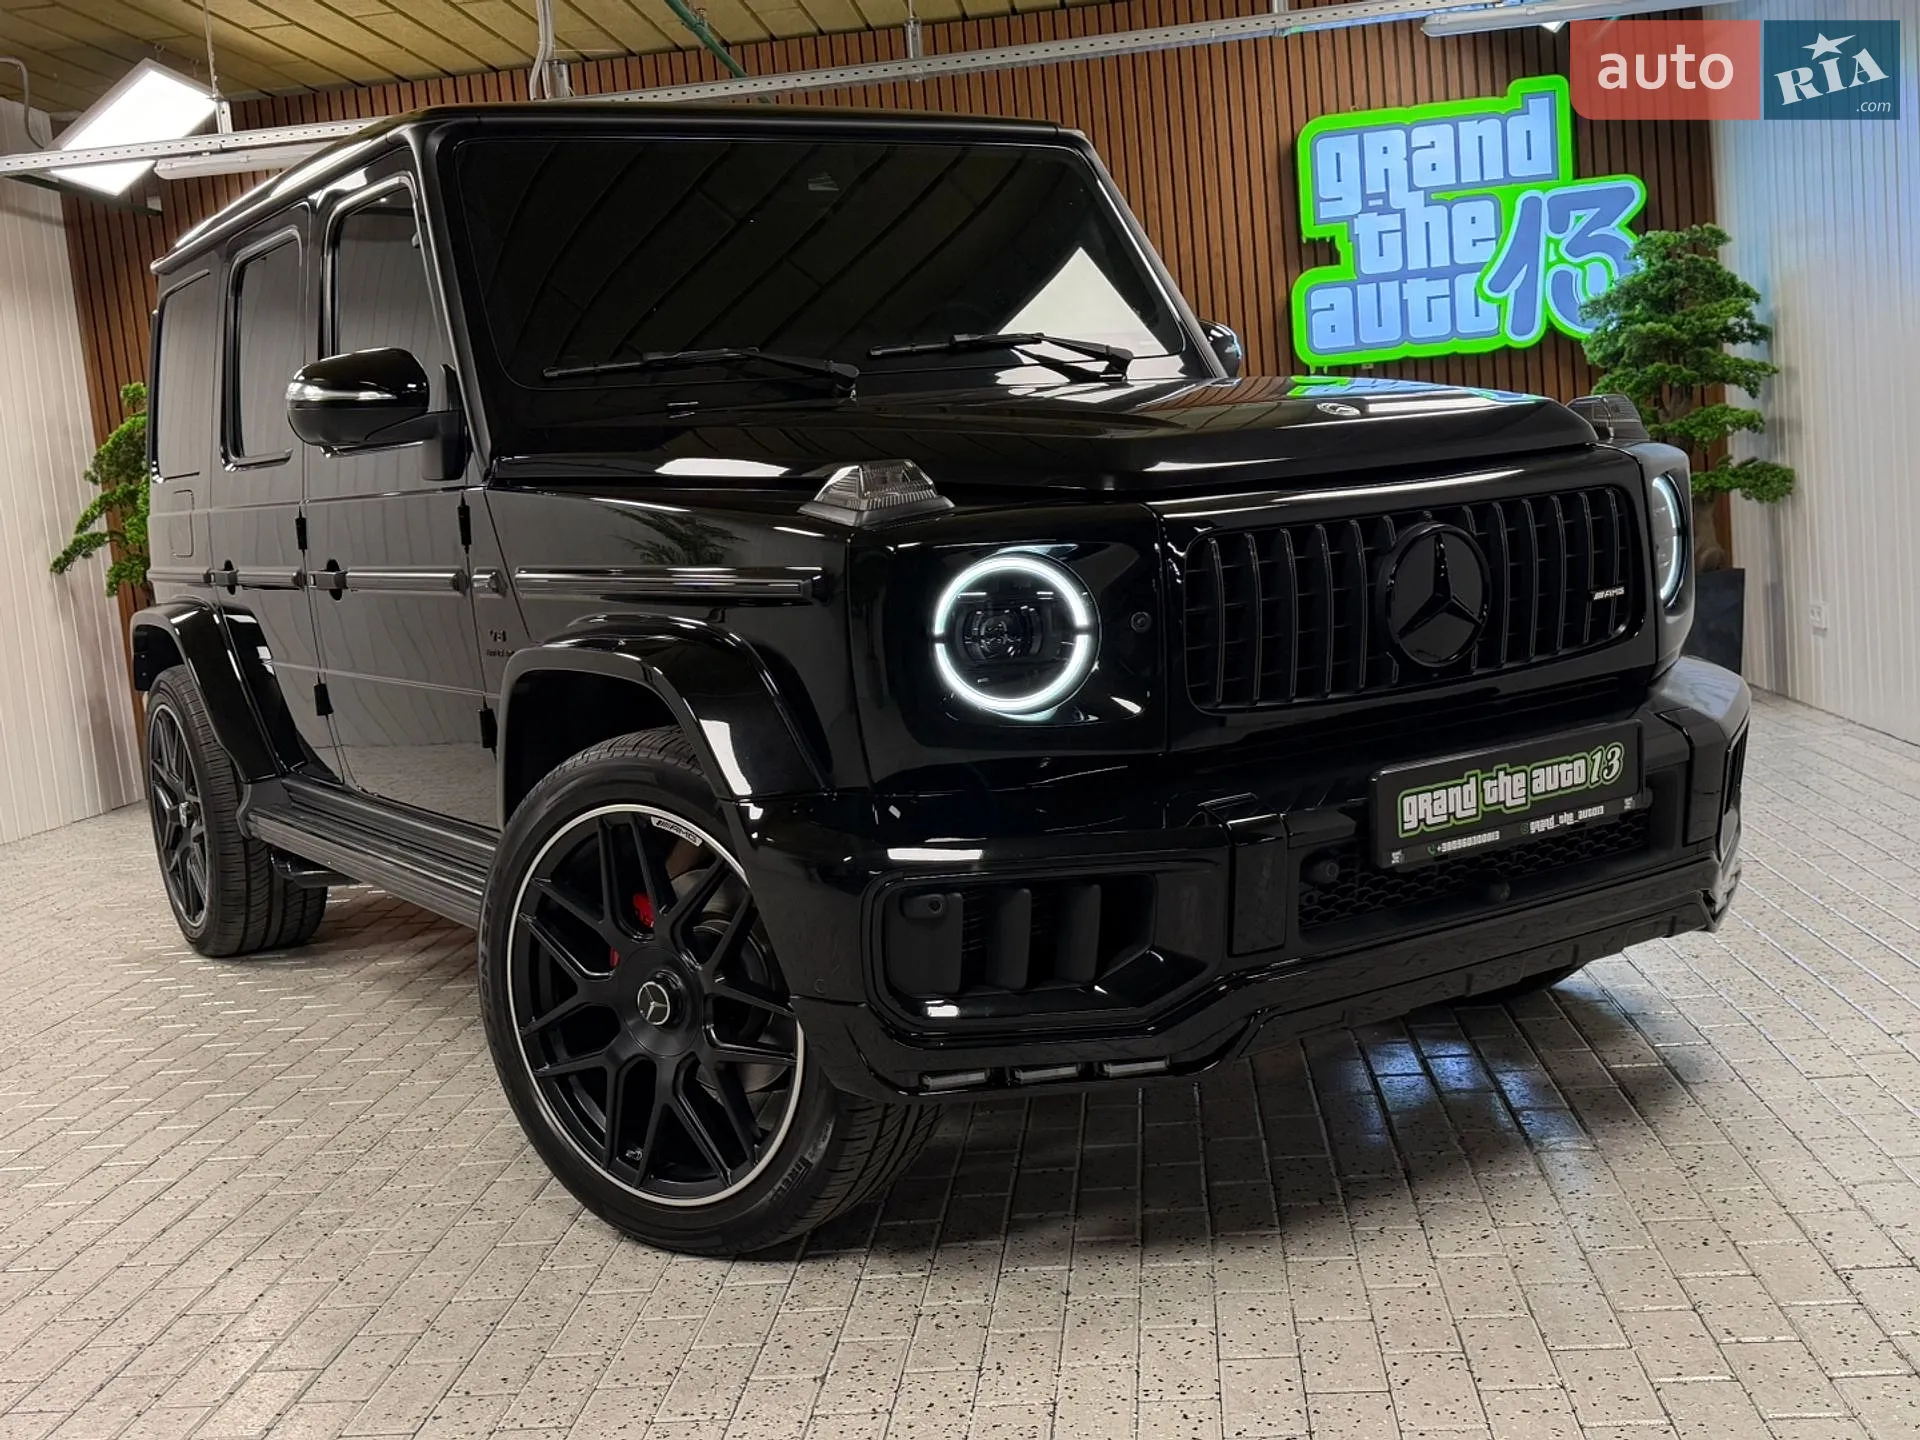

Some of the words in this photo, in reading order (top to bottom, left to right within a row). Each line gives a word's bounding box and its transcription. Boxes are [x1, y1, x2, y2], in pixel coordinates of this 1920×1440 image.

[1317, 95, 1554, 221] grand
[1354, 192, 1498, 275] the
[1309, 272, 1499, 351] auto
[1402, 776, 1478, 831] grand
[1483, 768, 1527, 808] the
